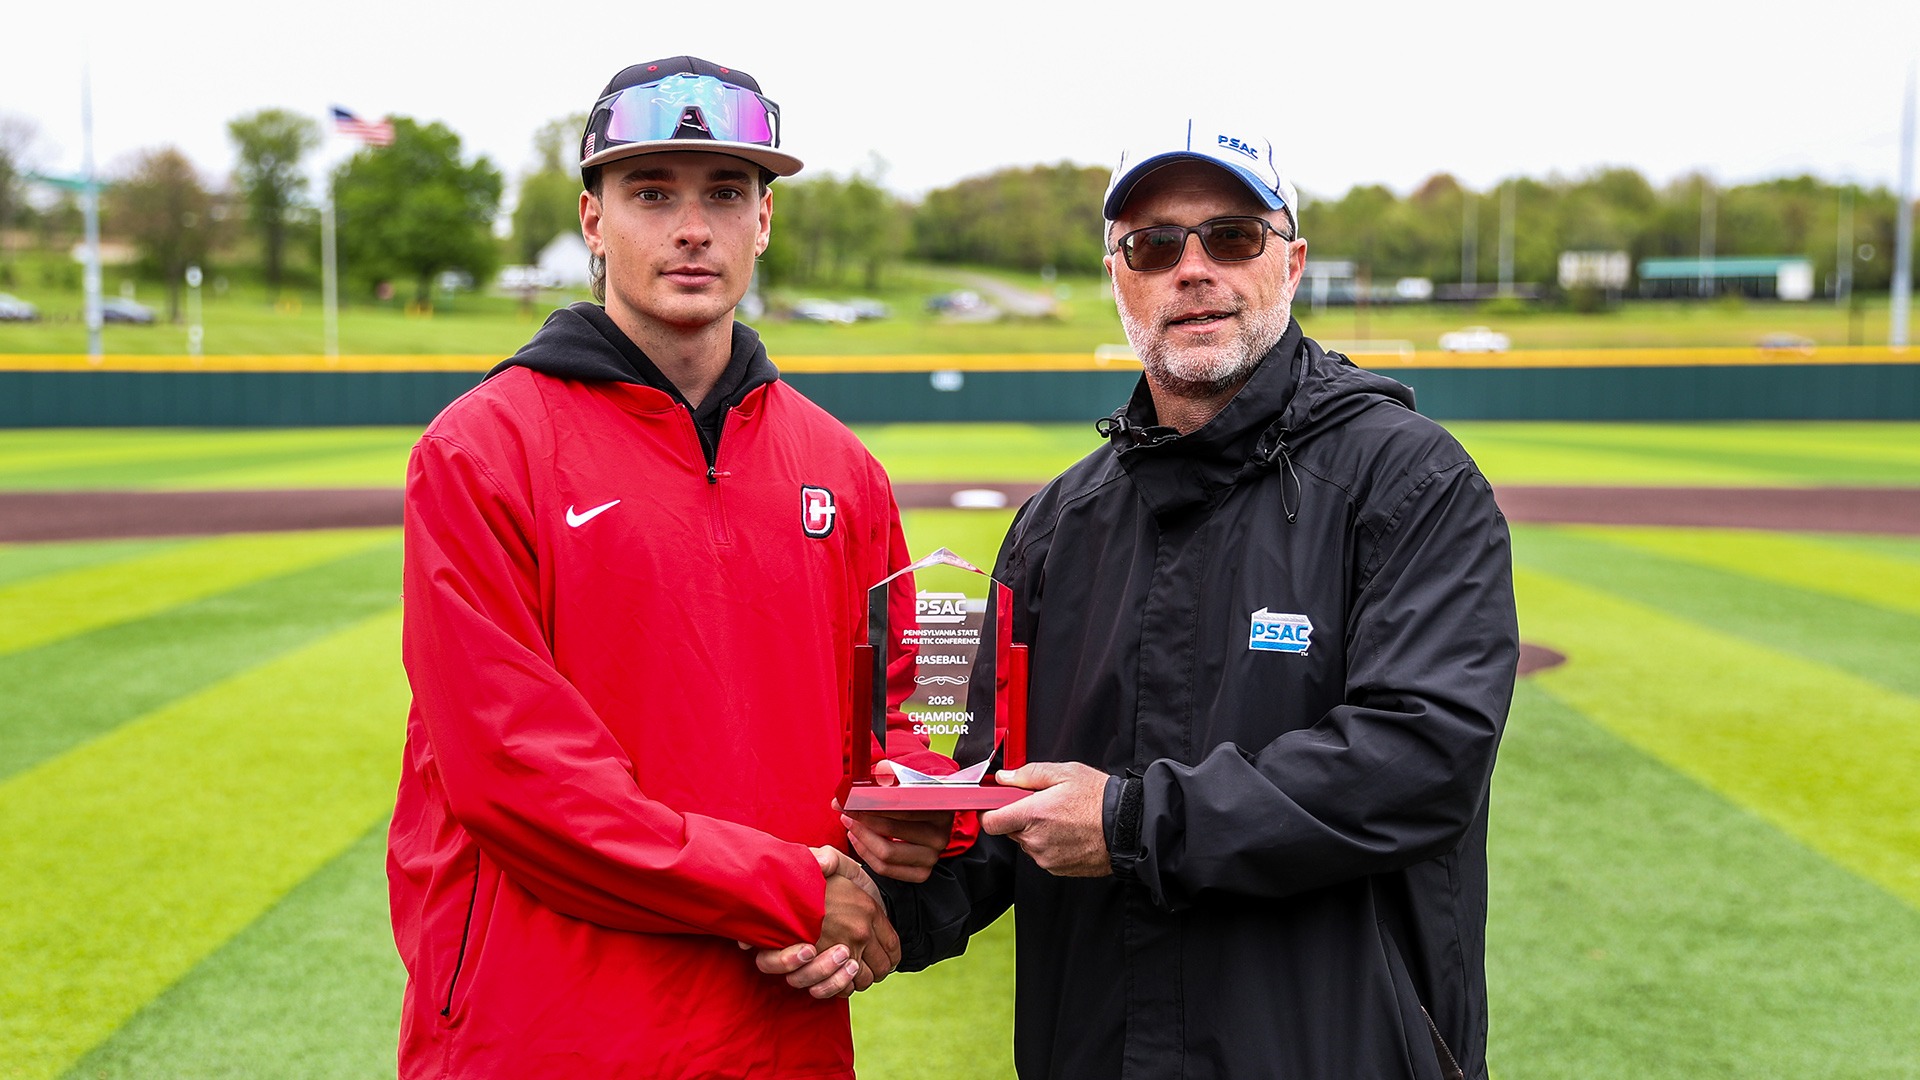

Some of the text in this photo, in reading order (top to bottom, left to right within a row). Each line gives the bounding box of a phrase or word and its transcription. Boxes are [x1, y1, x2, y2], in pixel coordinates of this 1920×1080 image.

[1218, 135, 1258, 159] PSAC
[915, 599, 967, 615] PSAC
[1252, 621, 1308, 642] PSAC
[901, 637, 981, 645] ATHLETIC CONFERENCE
[915, 655, 969, 665] BASEBALL
[927, 695, 955, 706] 2026
[907, 711, 974, 723] CHAMPION
[912, 724, 970, 735] SCHOLAR
